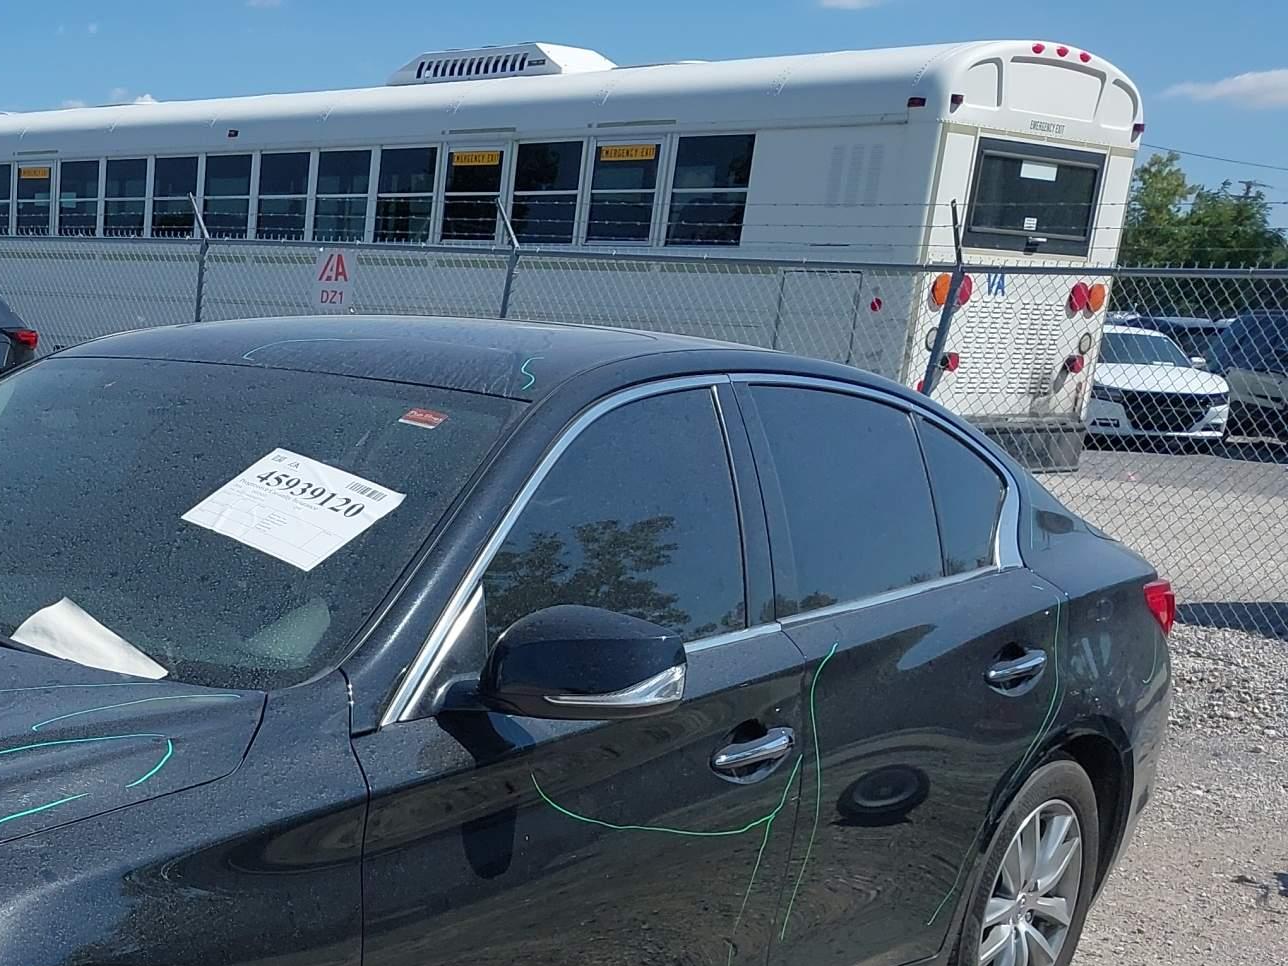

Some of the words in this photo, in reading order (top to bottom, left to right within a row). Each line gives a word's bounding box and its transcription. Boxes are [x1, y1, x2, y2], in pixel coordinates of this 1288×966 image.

[987, 271, 1005, 296] VA
[320, 289, 344, 304] DZ1
[256, 469, 365, 518] 45939120
